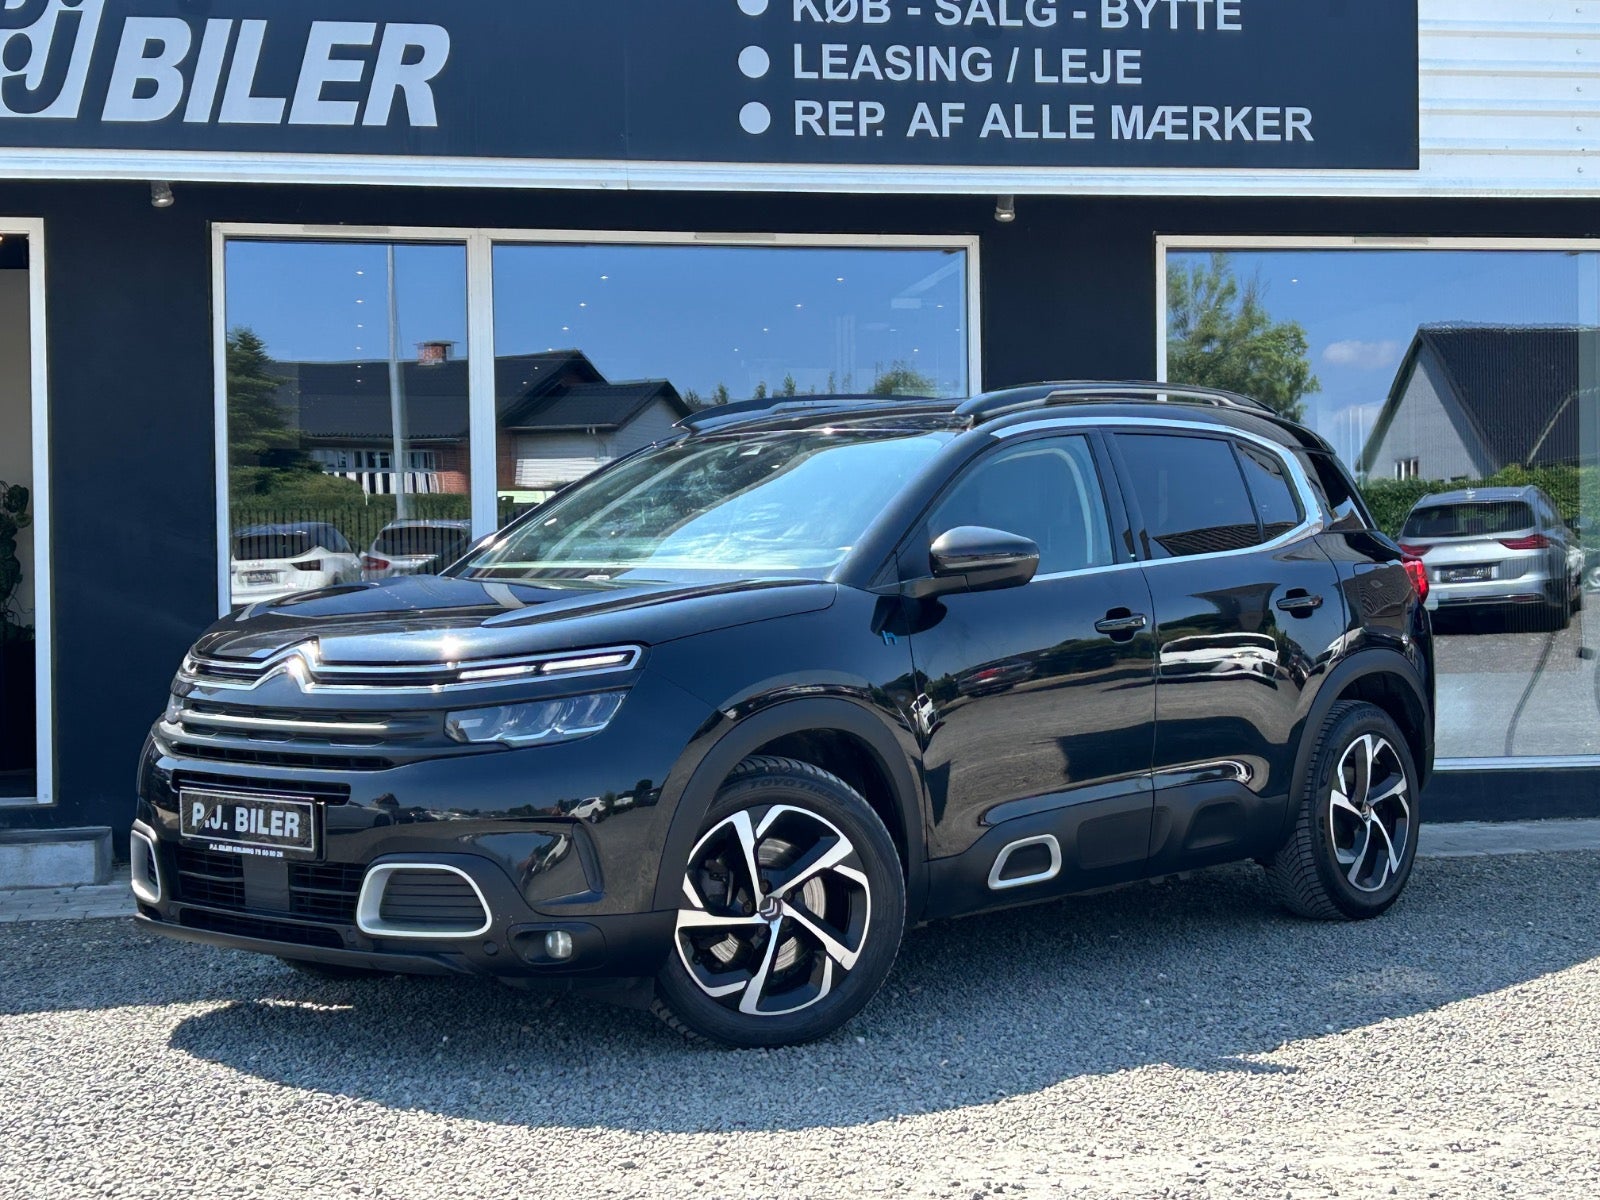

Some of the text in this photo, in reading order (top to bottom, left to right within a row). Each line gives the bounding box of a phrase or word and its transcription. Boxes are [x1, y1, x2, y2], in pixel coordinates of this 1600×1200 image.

[794, 0, 891, 24] KØB
[934, 0, 1057, 28] SALG
[1100, 0, 1242, 31] BYTTE
[101, 17, 451, 127] BILER
[794, 43, 993, 83] LEASING
[1034, 48, 1142, 85] LEJE
[795, 99, 1315, 142] REP. AF ALLE MÆRKER
[191, 801, 301, 838] P.J. BILER
